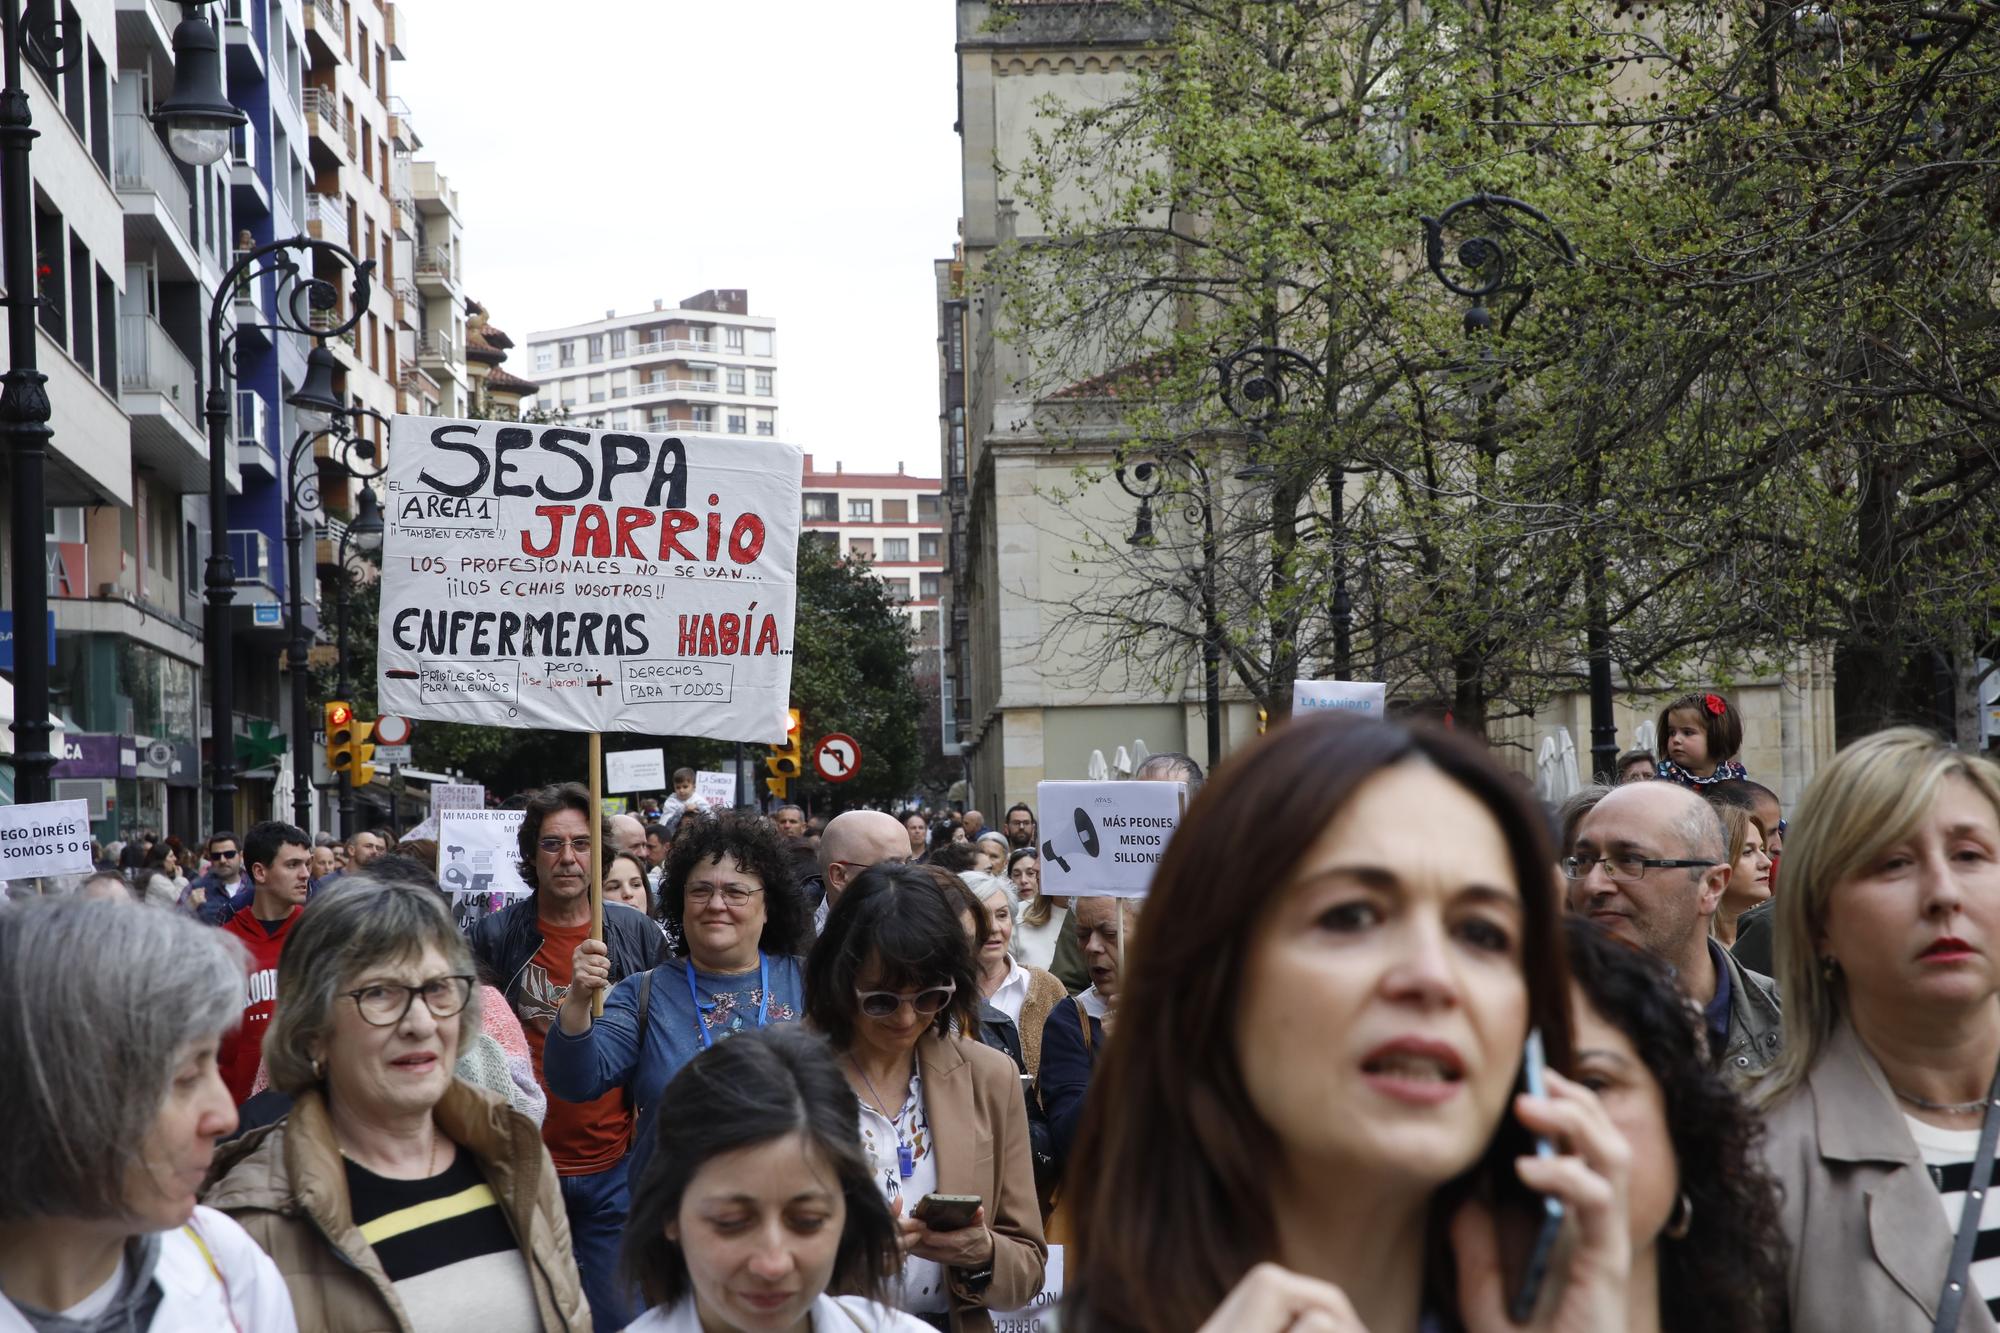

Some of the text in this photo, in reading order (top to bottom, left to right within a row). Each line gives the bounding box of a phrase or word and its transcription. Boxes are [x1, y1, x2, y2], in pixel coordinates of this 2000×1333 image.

[418, 424, 688, 509] SESPA
[389, 481, 404, 492] EL
[411, 556, 447, 574] LOS
[636, 563, 658, 576] NO
[674, 565, 695, 578] SE
[500, 581, 565, 597] ECHAIS
[392, 606, 649, 657] ENFERMERAS
[629, 665, 703, 679] DERECHOS
[422, 683, 510, 693] PARA ALGUNOS
[629, 682, 724, 698] PARA TODOS
[1301, 697, 1316, 707] LA
[65, 743, 83, 760] CA
[443, 812, 528, 821] MI MADRE NO CON
[1102, 814, 1176, 829] MÁS PEONES,
[1, 822, 76, 841] EGO DIRÉIS
[1120, 835, 1161, 846] MENOS
[3, 844, 53, 859] SOMOS
[56, 843, 64, 854] 5
[82, 841, 90, 851] 6
[1114, 852, 1160, 863] SILLONE
